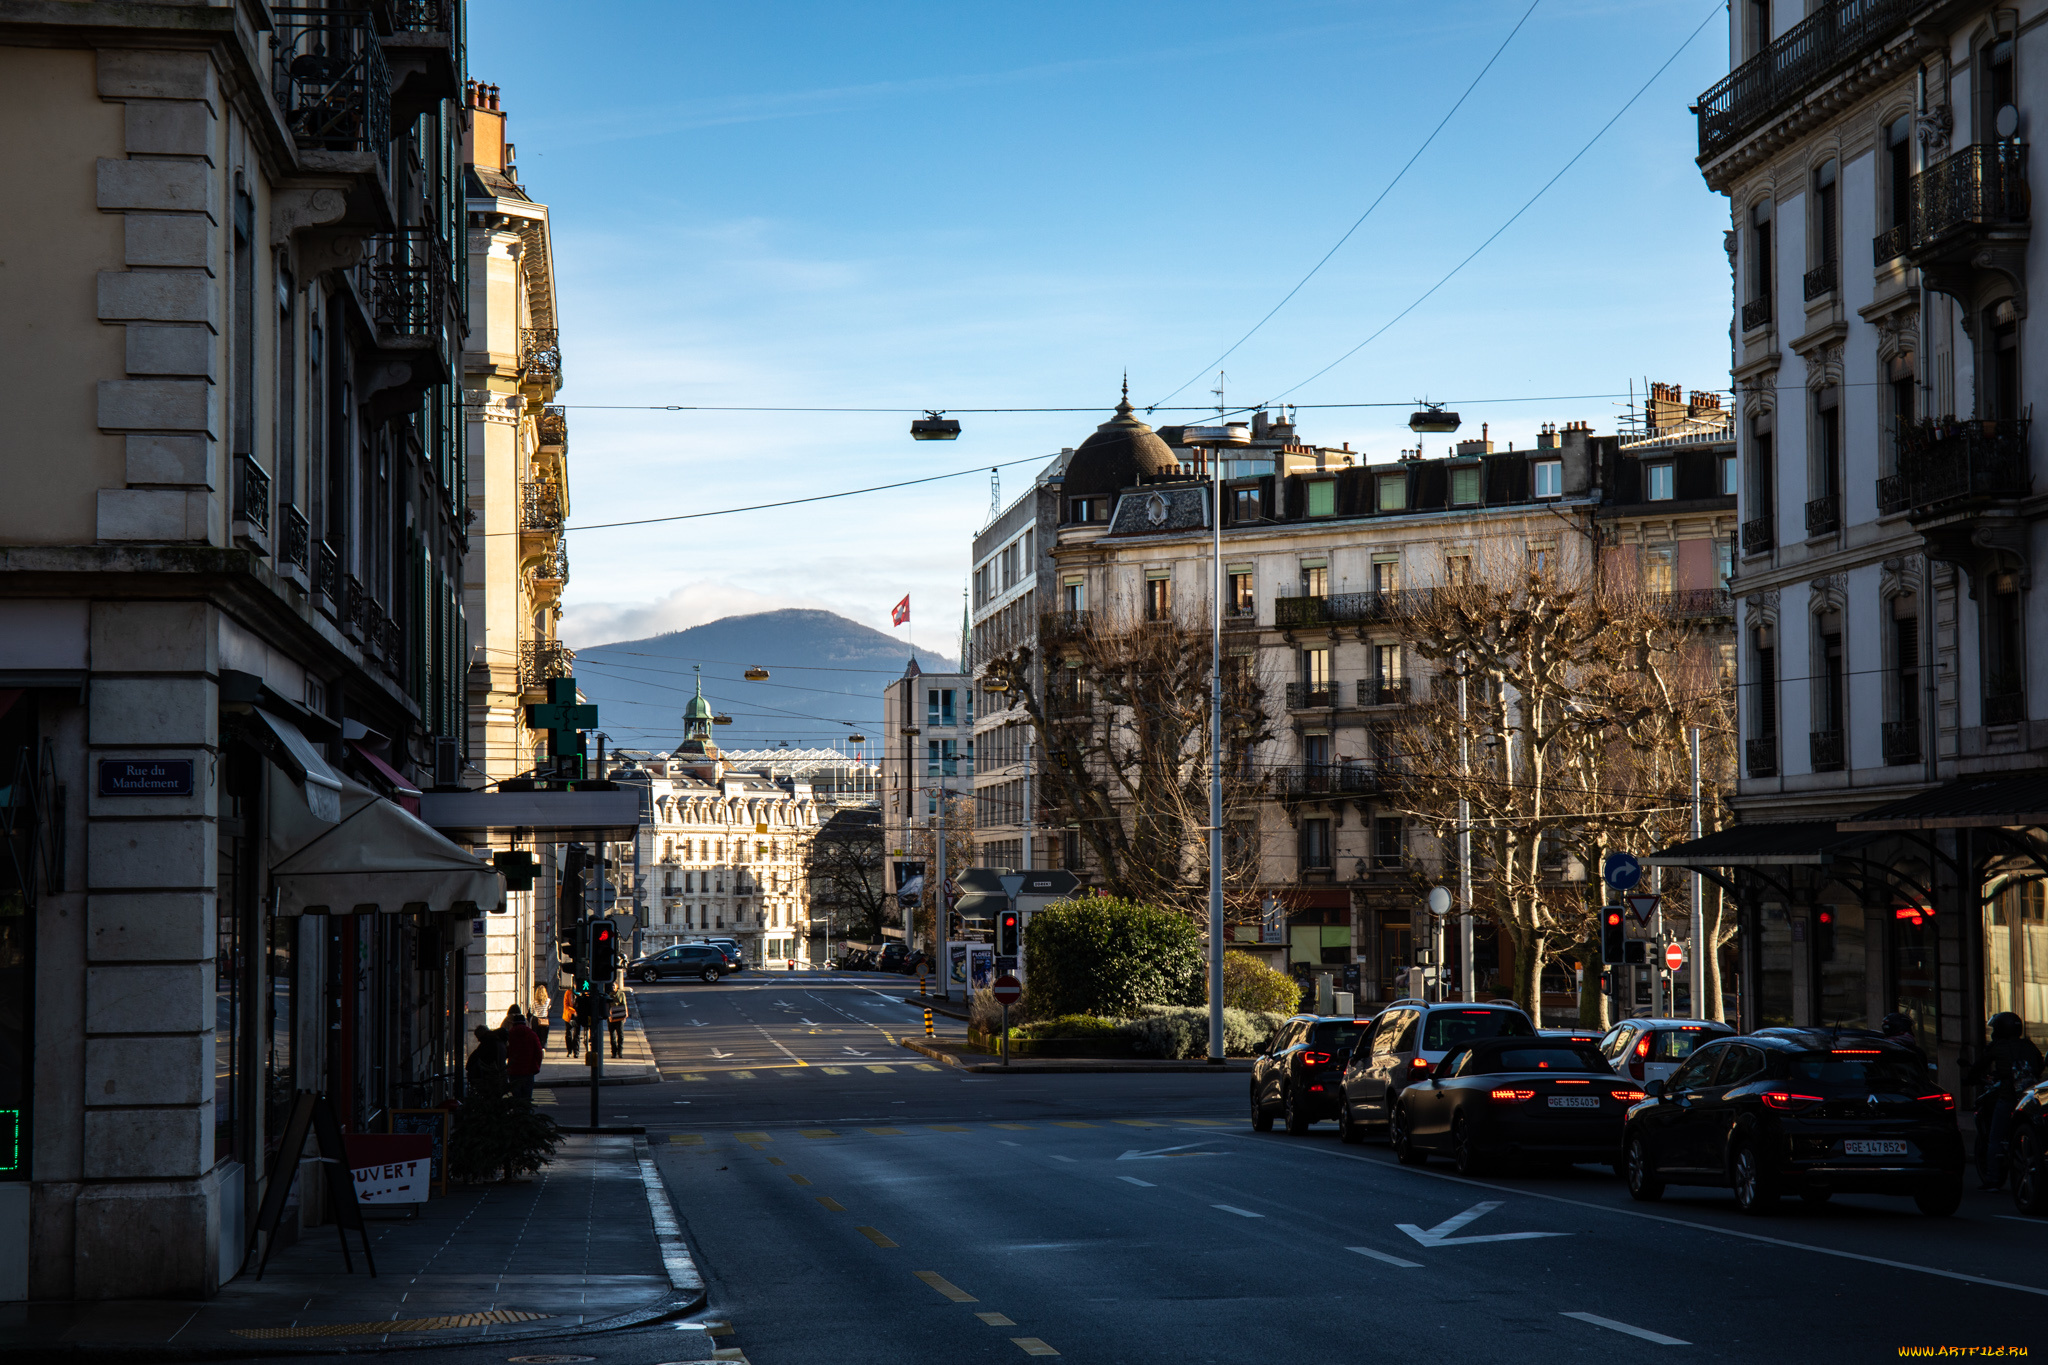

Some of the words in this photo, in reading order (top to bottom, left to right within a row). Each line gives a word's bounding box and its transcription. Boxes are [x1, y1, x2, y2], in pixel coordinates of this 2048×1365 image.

[126, 764, 148, 776] Rue
[150, 764, 166, 776] du
[112, 777, 180, 789] Mandement
[352, 1162, 417, 1182] UVERT
